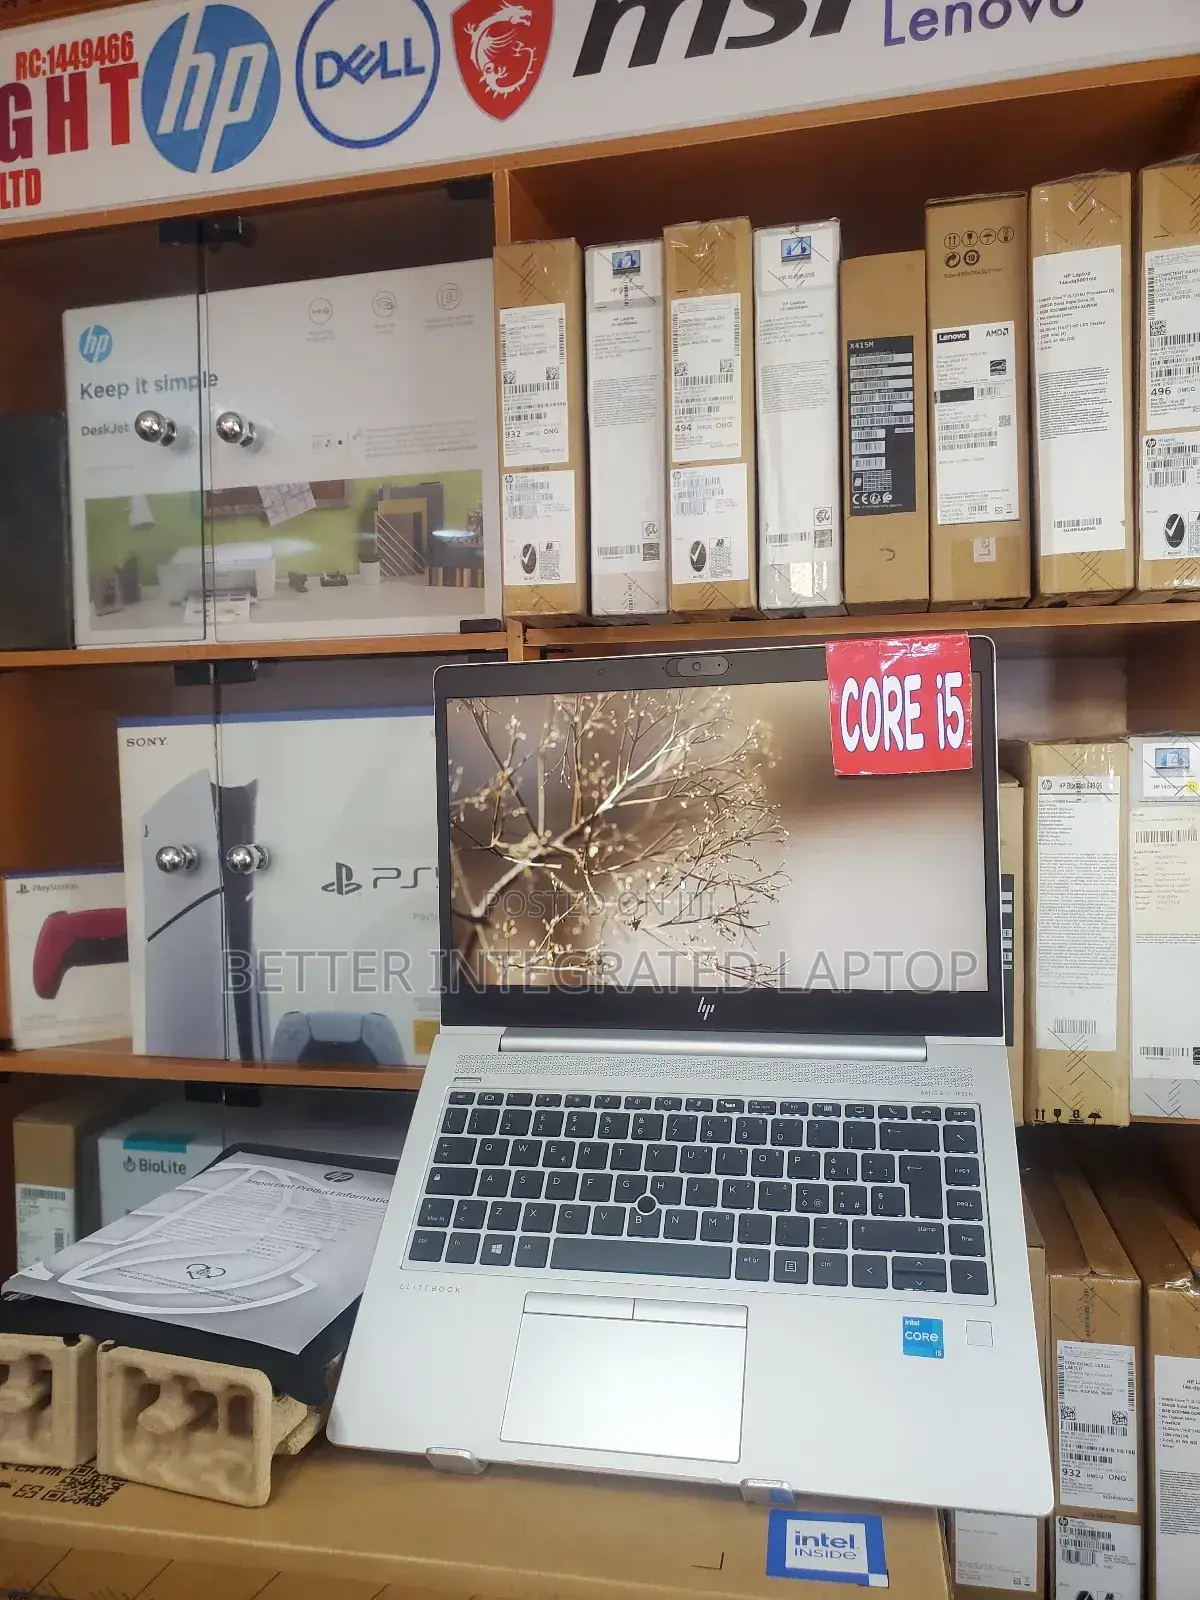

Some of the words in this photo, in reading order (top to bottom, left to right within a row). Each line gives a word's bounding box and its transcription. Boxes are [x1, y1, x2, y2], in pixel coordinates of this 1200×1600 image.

[16, 31, 134, 80] RC:1449466
[315, 37, 425, 90] DELL
[157, 5, 268, 173] hp
[0, 168, 42, 209] LTD
[939, 333, 966, 341] Lenovo
[986, 329, 1002, 337] AMD
[850, 341, 874, 349] X415M
[80, 383, 129, 400] Keep
[136, 376, 148, 394] it
[154, 370, 218, 392] simple
[1151, 387, 1171, 396] 496
[82, 423, 129, 436] DeskJet
[505, 430, 521, 438] 932
[675, 424, 692, 432] 494
[840, 673, 924, 753] CORE
[936, 670, 964, 751] i5
[126, 737, 167, 748] SONY
[372, 867, 438, 888] PS
[32, 884, 78, 893] PlayStation
[139, 1158, 186, 1174] BioLite
[246, 1178, 295, 1190] Important
[296, 1185, 337, 1196] Product
[400, 1284, 461, 1293] ELITEBOOK
[1062, 1468, 1081, 1477] 932
[1109, 1474, 1126, 1482] ONG
[794, 1531, 856, 1549] intel
